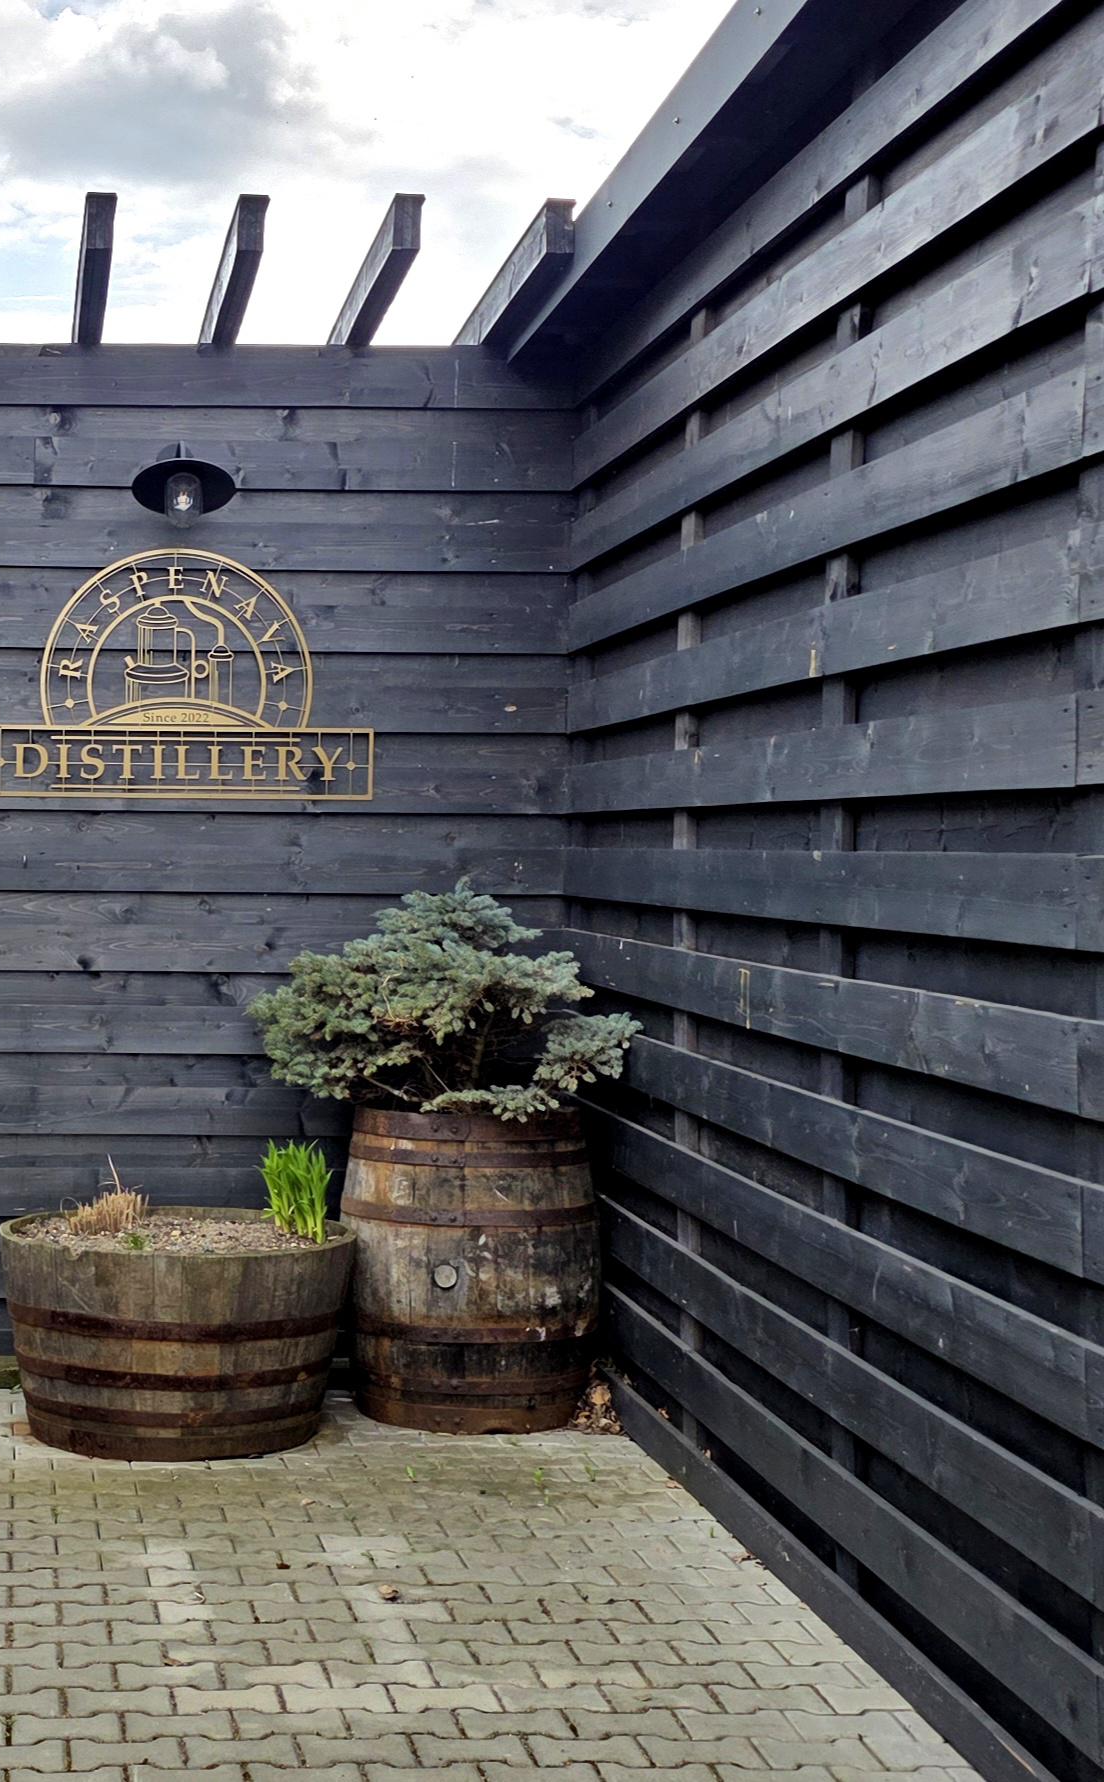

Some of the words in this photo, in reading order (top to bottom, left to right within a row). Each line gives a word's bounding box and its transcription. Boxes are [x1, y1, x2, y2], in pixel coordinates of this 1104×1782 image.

[58, 566, 295, 684] RASPENAVA
[142, 712, 178, 723] Since
[180, 712, 210, 723] 2022
[12, 742, 344, 782] DISTILLERY
